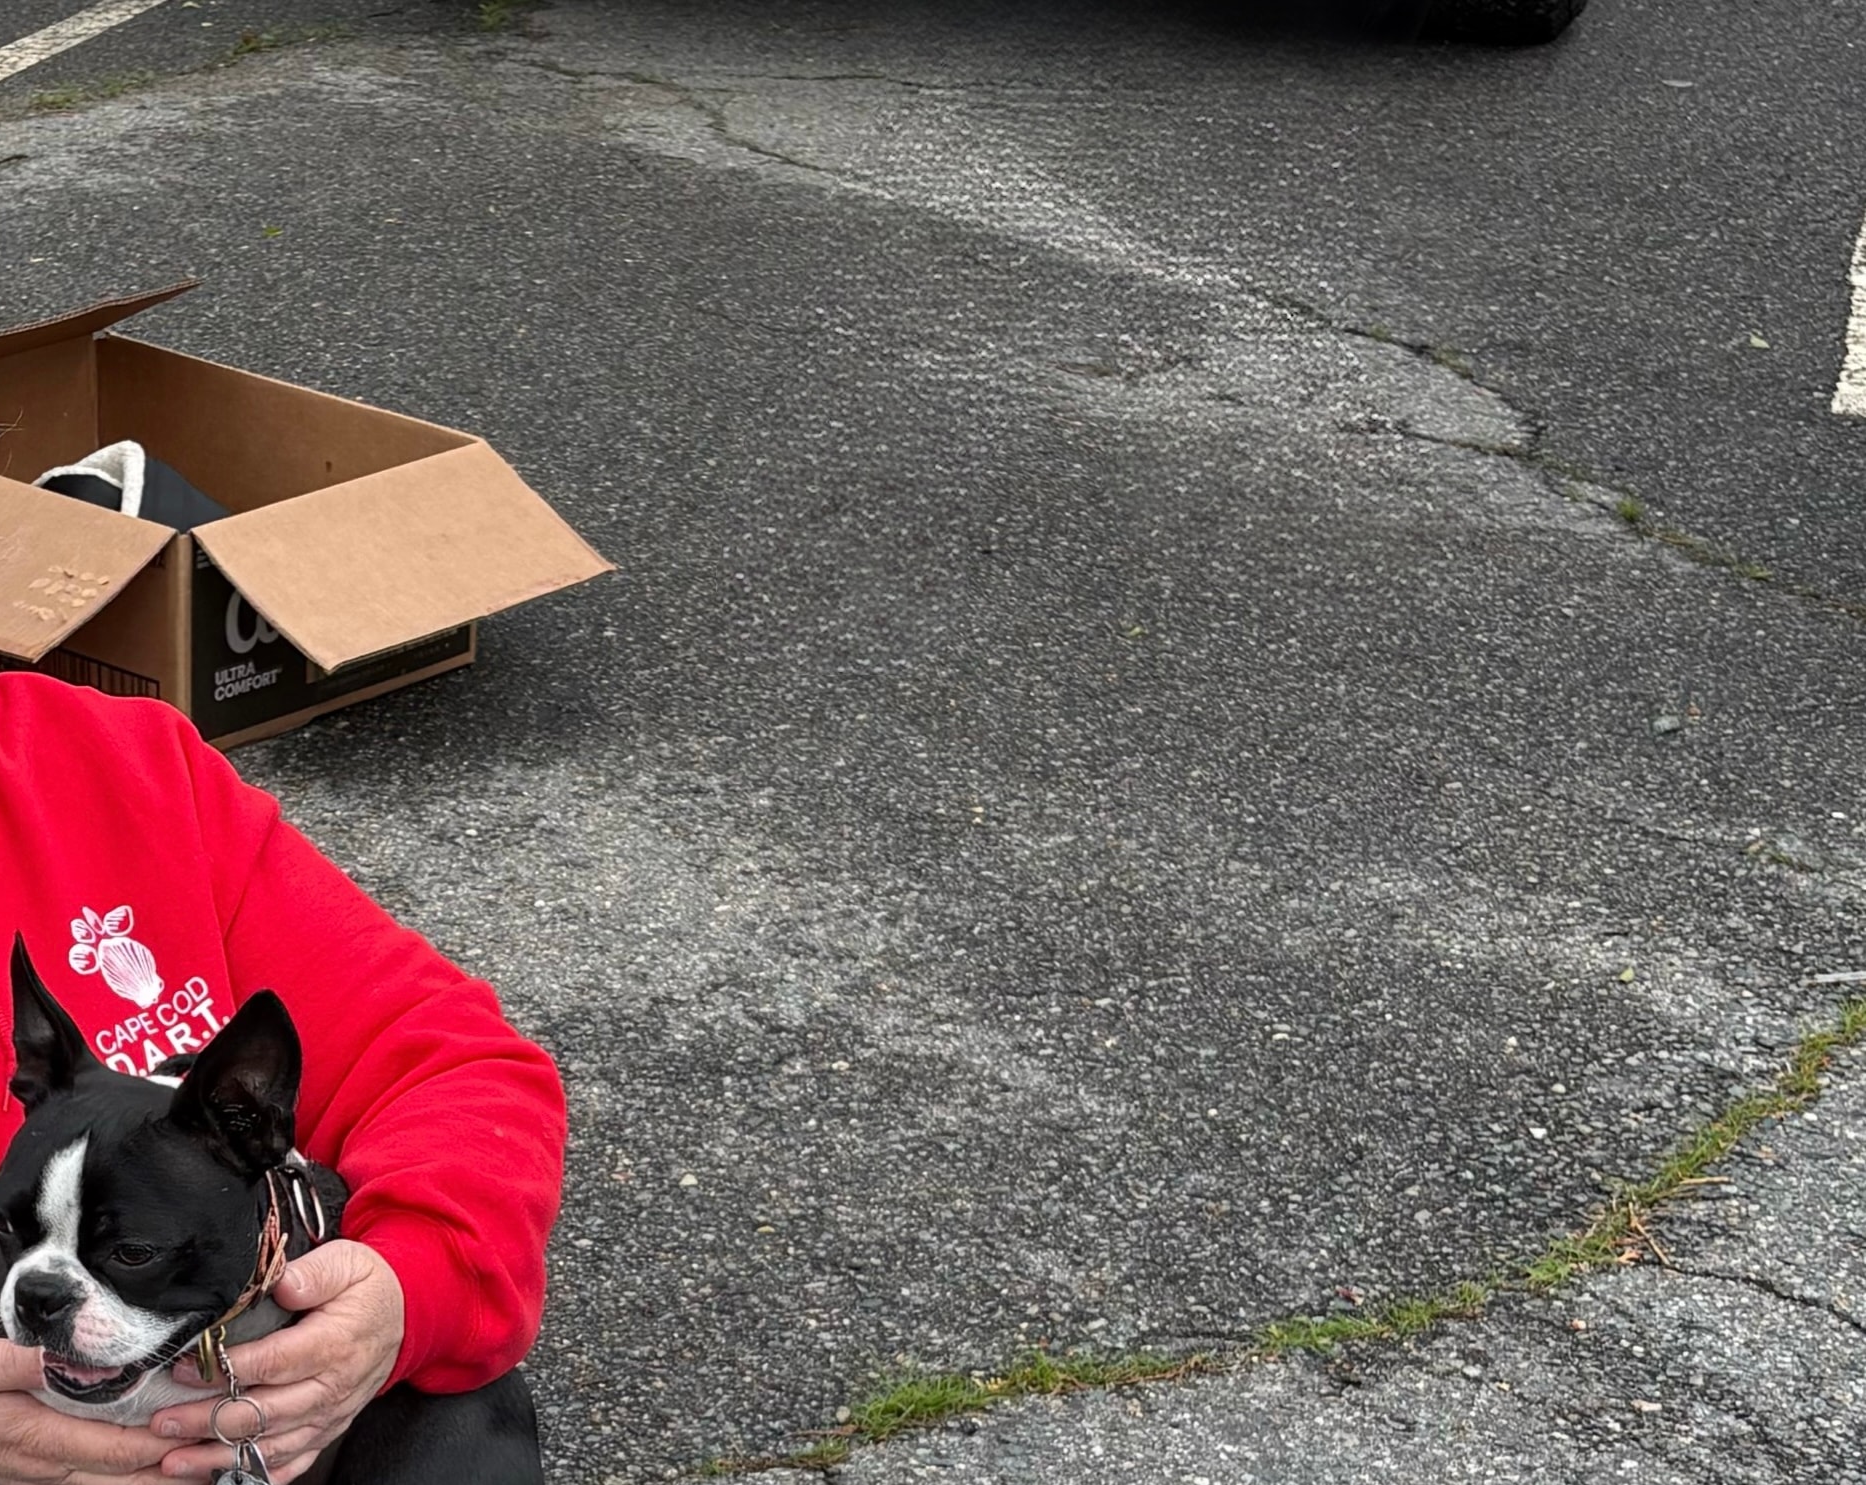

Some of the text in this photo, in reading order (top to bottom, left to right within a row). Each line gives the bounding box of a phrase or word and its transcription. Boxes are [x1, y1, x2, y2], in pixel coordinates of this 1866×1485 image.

[215, 661, 256, 685] ULTRA
[95, 976, 209, 1054] CAPE COD
[105, 998, 230, 1077] D.AR.T.
